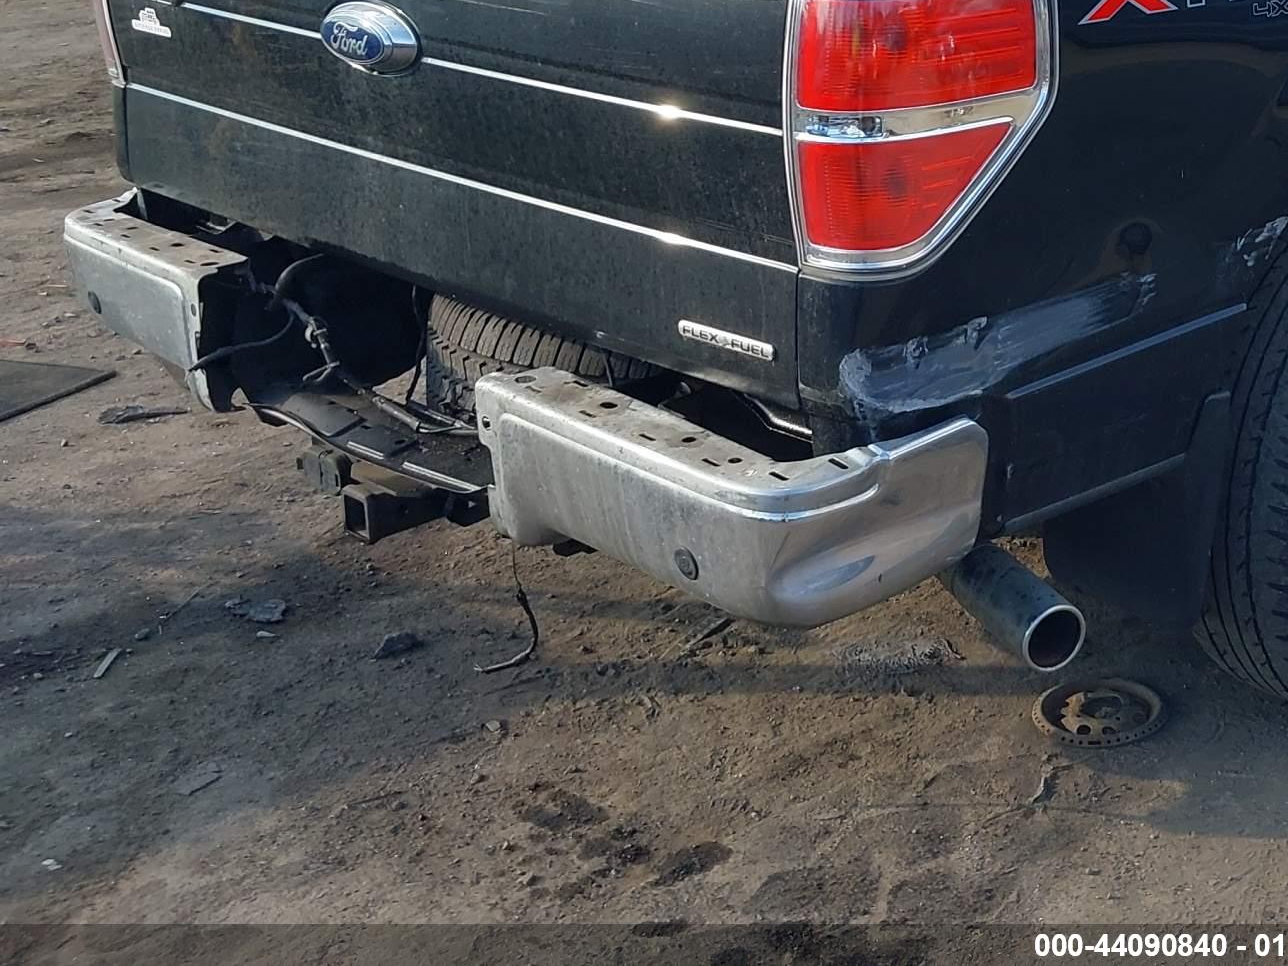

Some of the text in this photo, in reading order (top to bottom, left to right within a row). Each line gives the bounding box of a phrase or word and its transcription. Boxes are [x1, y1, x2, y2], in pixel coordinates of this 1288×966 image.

[330, 21, 368, 56] Ford
[683, 325, 769, 358] FLEX FUEL
